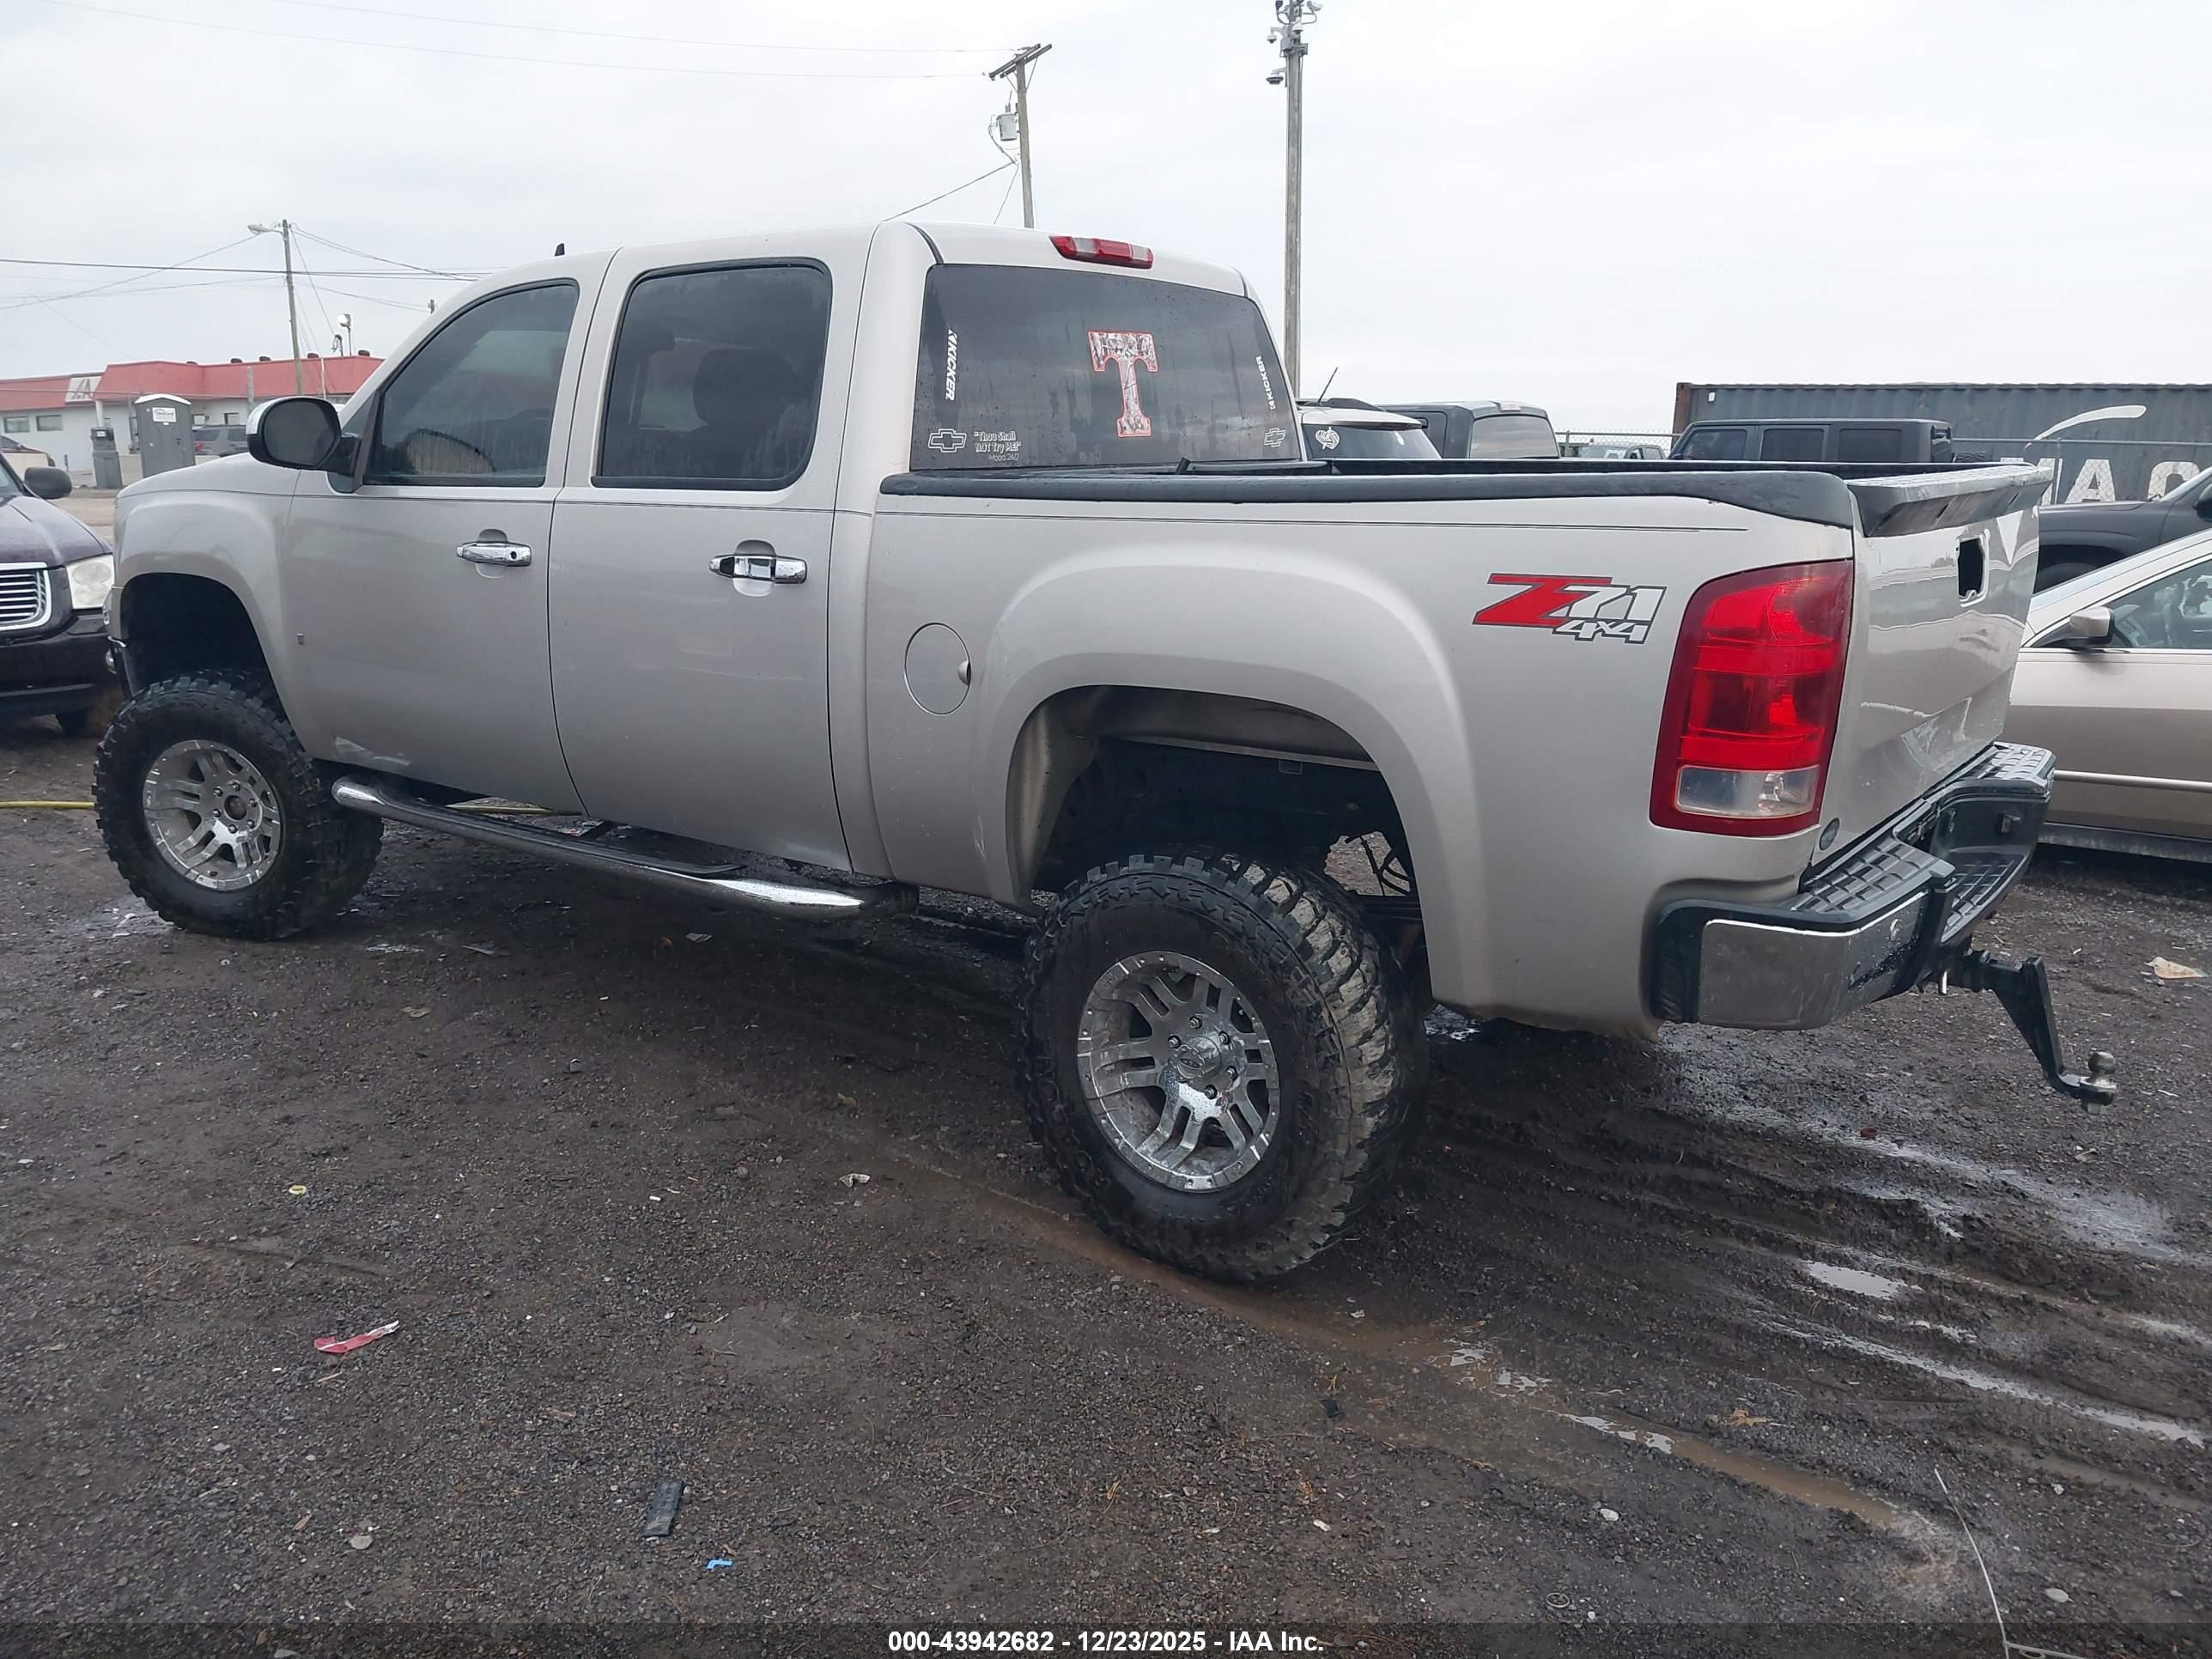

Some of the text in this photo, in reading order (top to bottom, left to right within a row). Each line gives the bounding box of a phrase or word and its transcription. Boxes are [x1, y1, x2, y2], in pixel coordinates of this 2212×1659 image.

[945, 340, 957, 401] KICKER
[1087, 330, 1158, 437] T
[1255, 356, 1273, 401] KICKER
[1472, 573, 1668, 630] Z71
